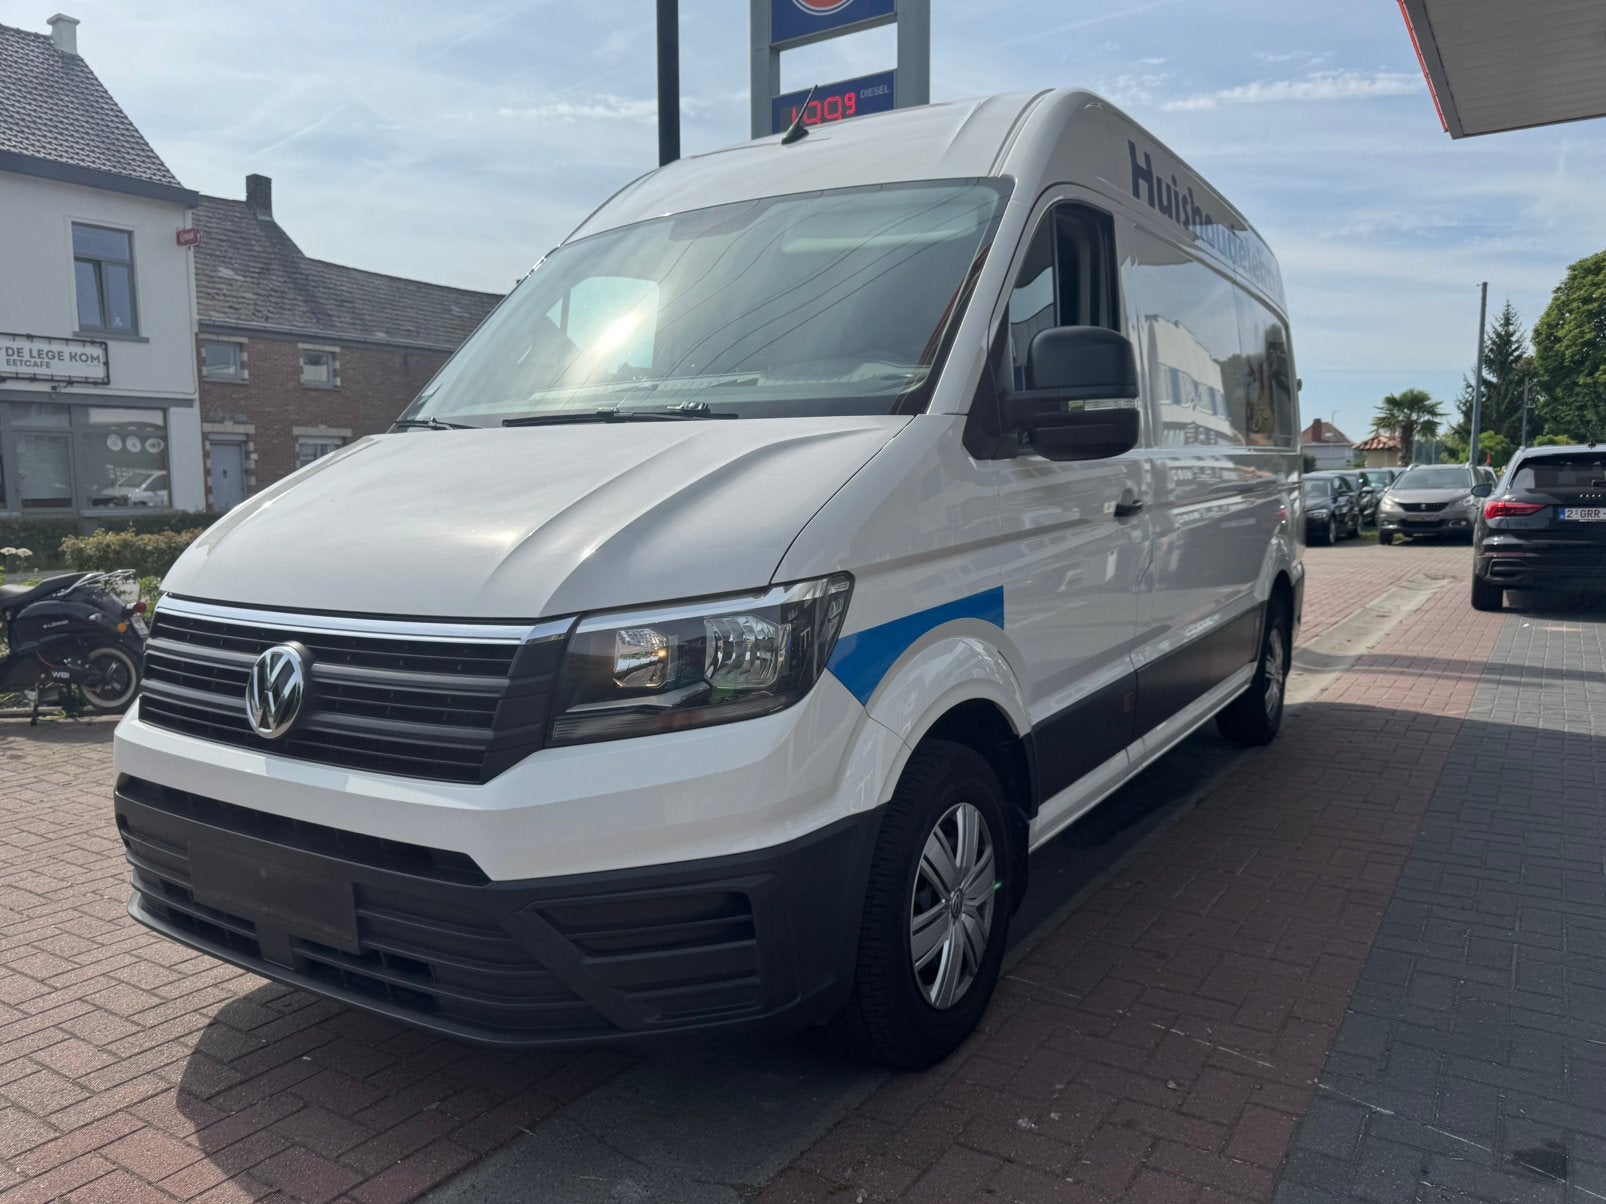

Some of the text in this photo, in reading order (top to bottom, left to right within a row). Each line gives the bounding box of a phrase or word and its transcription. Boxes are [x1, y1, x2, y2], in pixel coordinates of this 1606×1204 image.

[860, 85, 890, 98] DIESEL
[5, 346, 101, 364] DE LEGE KOM
[6, 358, 51, 369] EETCAFE
